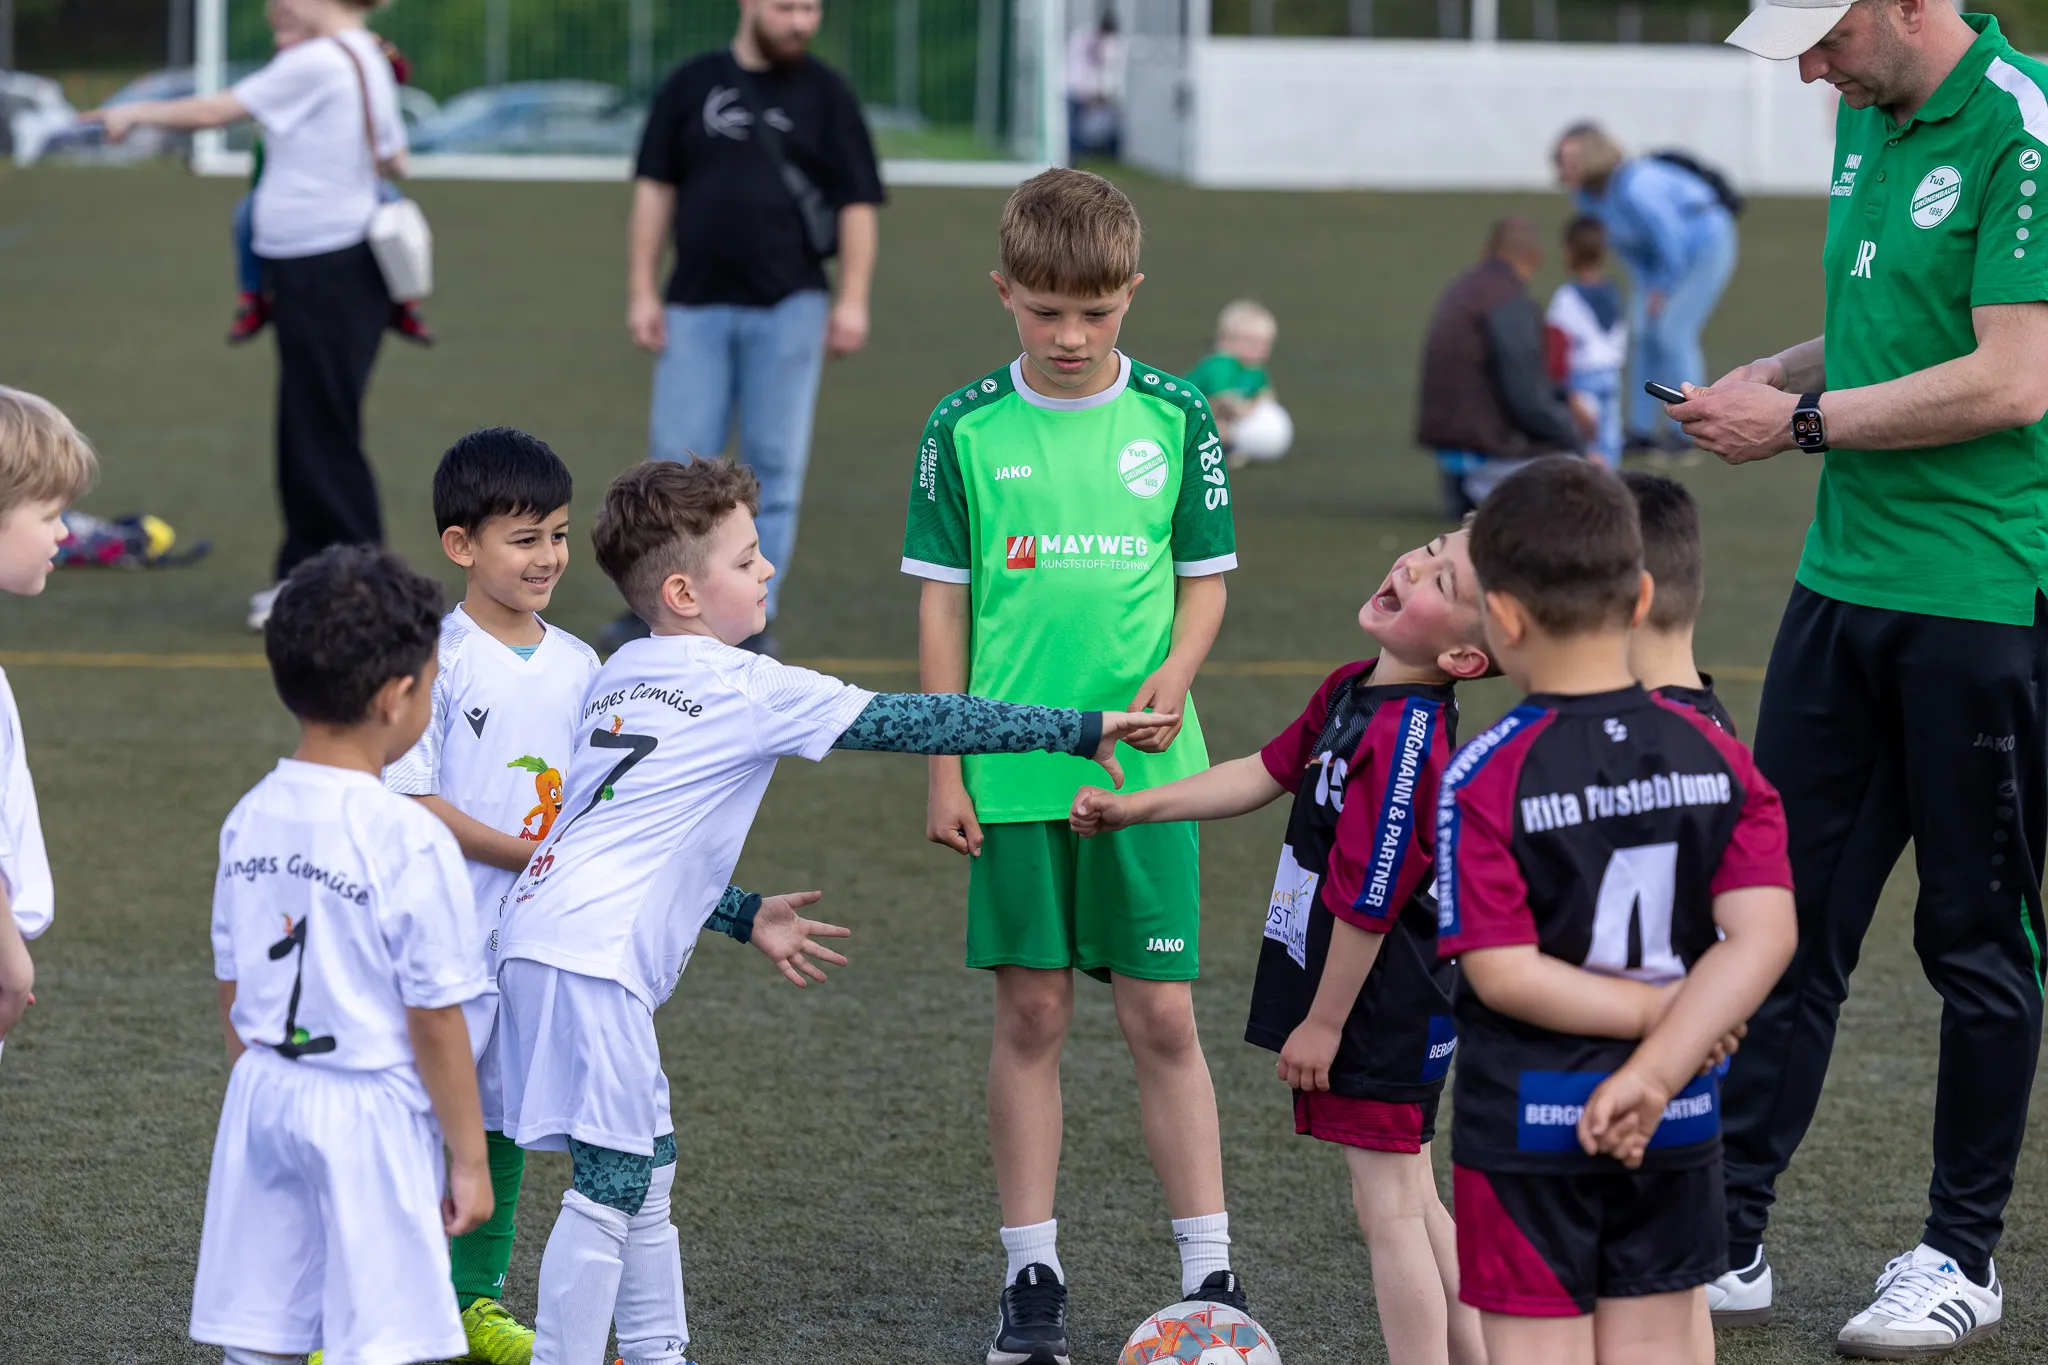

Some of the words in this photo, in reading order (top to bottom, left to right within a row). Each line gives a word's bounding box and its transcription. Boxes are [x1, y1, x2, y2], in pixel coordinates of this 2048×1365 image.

[1929, 175, 1945, 186] TuS
[1914, 184, 1958, 210] GRÜNENBAUM
[1929, 206, 1944, 217] 1895
[1850, 240, 1877, 279] JR
[1128, 448, 1147, 458] TuS
[920, 445, 928, 489] SPORT
[928, 437, 937, 503] ENGSTFELD
[995, 465, 1032, 480] JAKO
[1198, 431, 1228, 511] 1895
[1041, 534, 1148, 557] MAYWEG
[1041, 559, 1150, 570] KUNSTSTOFF-TECHNIK
[584, 689, 626, 719] unges
[629, 682, 703, 718] Gemüse
[1973, 733, 2015, 752] JAKO
[1391, 708, 1429, 805] BERGMANN
[551, 727, 658, 846] 7
[1388, 806, 1406, 820] &
[1520, 791, 1583, 833] Kita
[1584, 771, 1732, 821] Pusteblume
[1365, 823, 1402, 908] PARTNER
[223, 855, 278, 882] unges
[287, 854, 370, 906] Gemüse
[1273, 889, 1293, 905] KIT
[1146, 937, 1185, 952] JAKO
[1662, 1092, 1713, 1121] ARTNER
